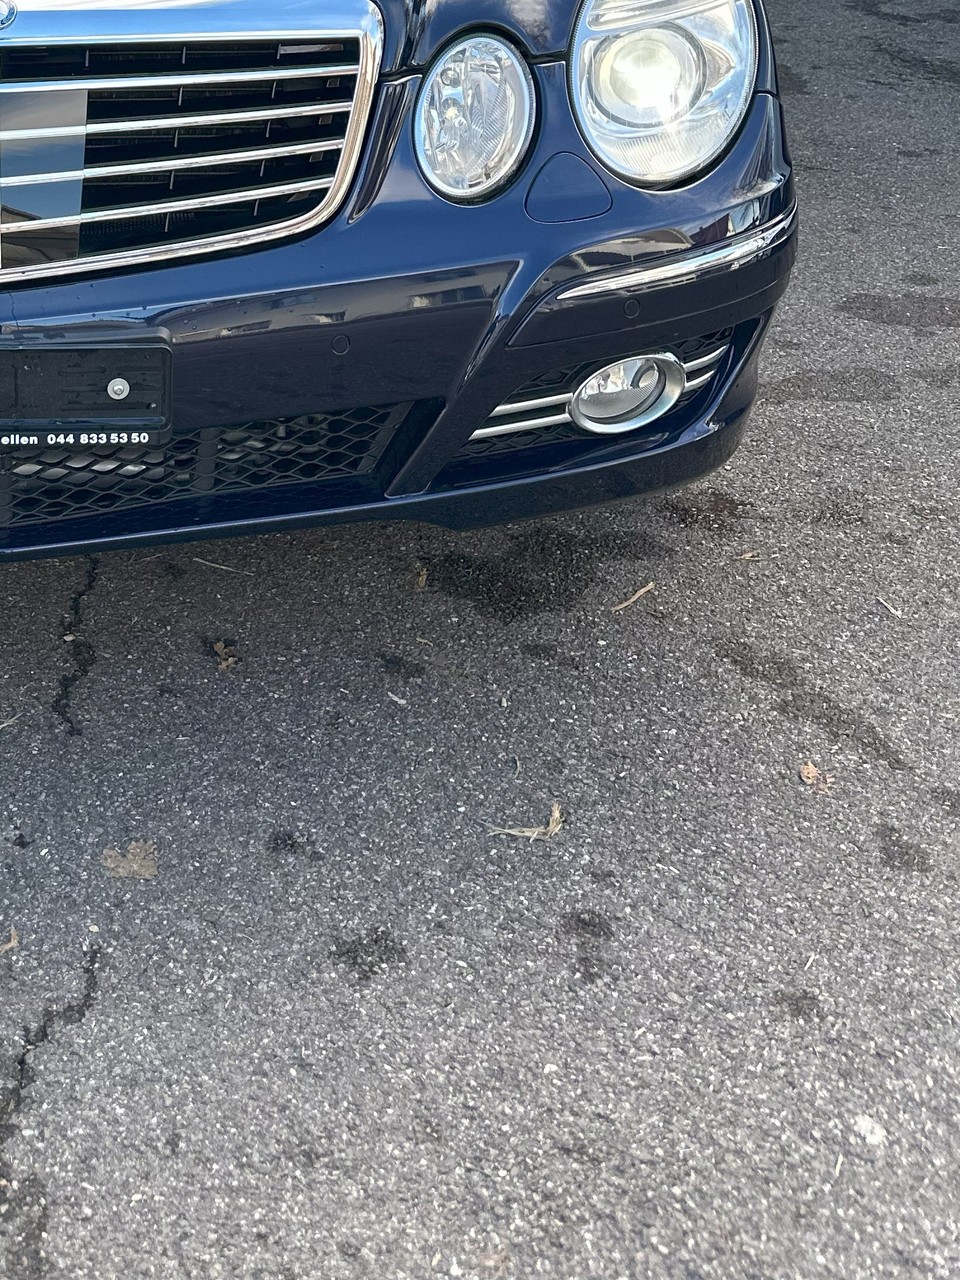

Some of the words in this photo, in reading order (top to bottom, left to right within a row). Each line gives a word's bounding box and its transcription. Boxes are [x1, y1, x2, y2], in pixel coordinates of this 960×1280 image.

[47, 433, 75, 445] 044
[79, 433, 108, 445] 833
[109, 433, 129, 445] 53
[130, 432, 149, 444] 50
